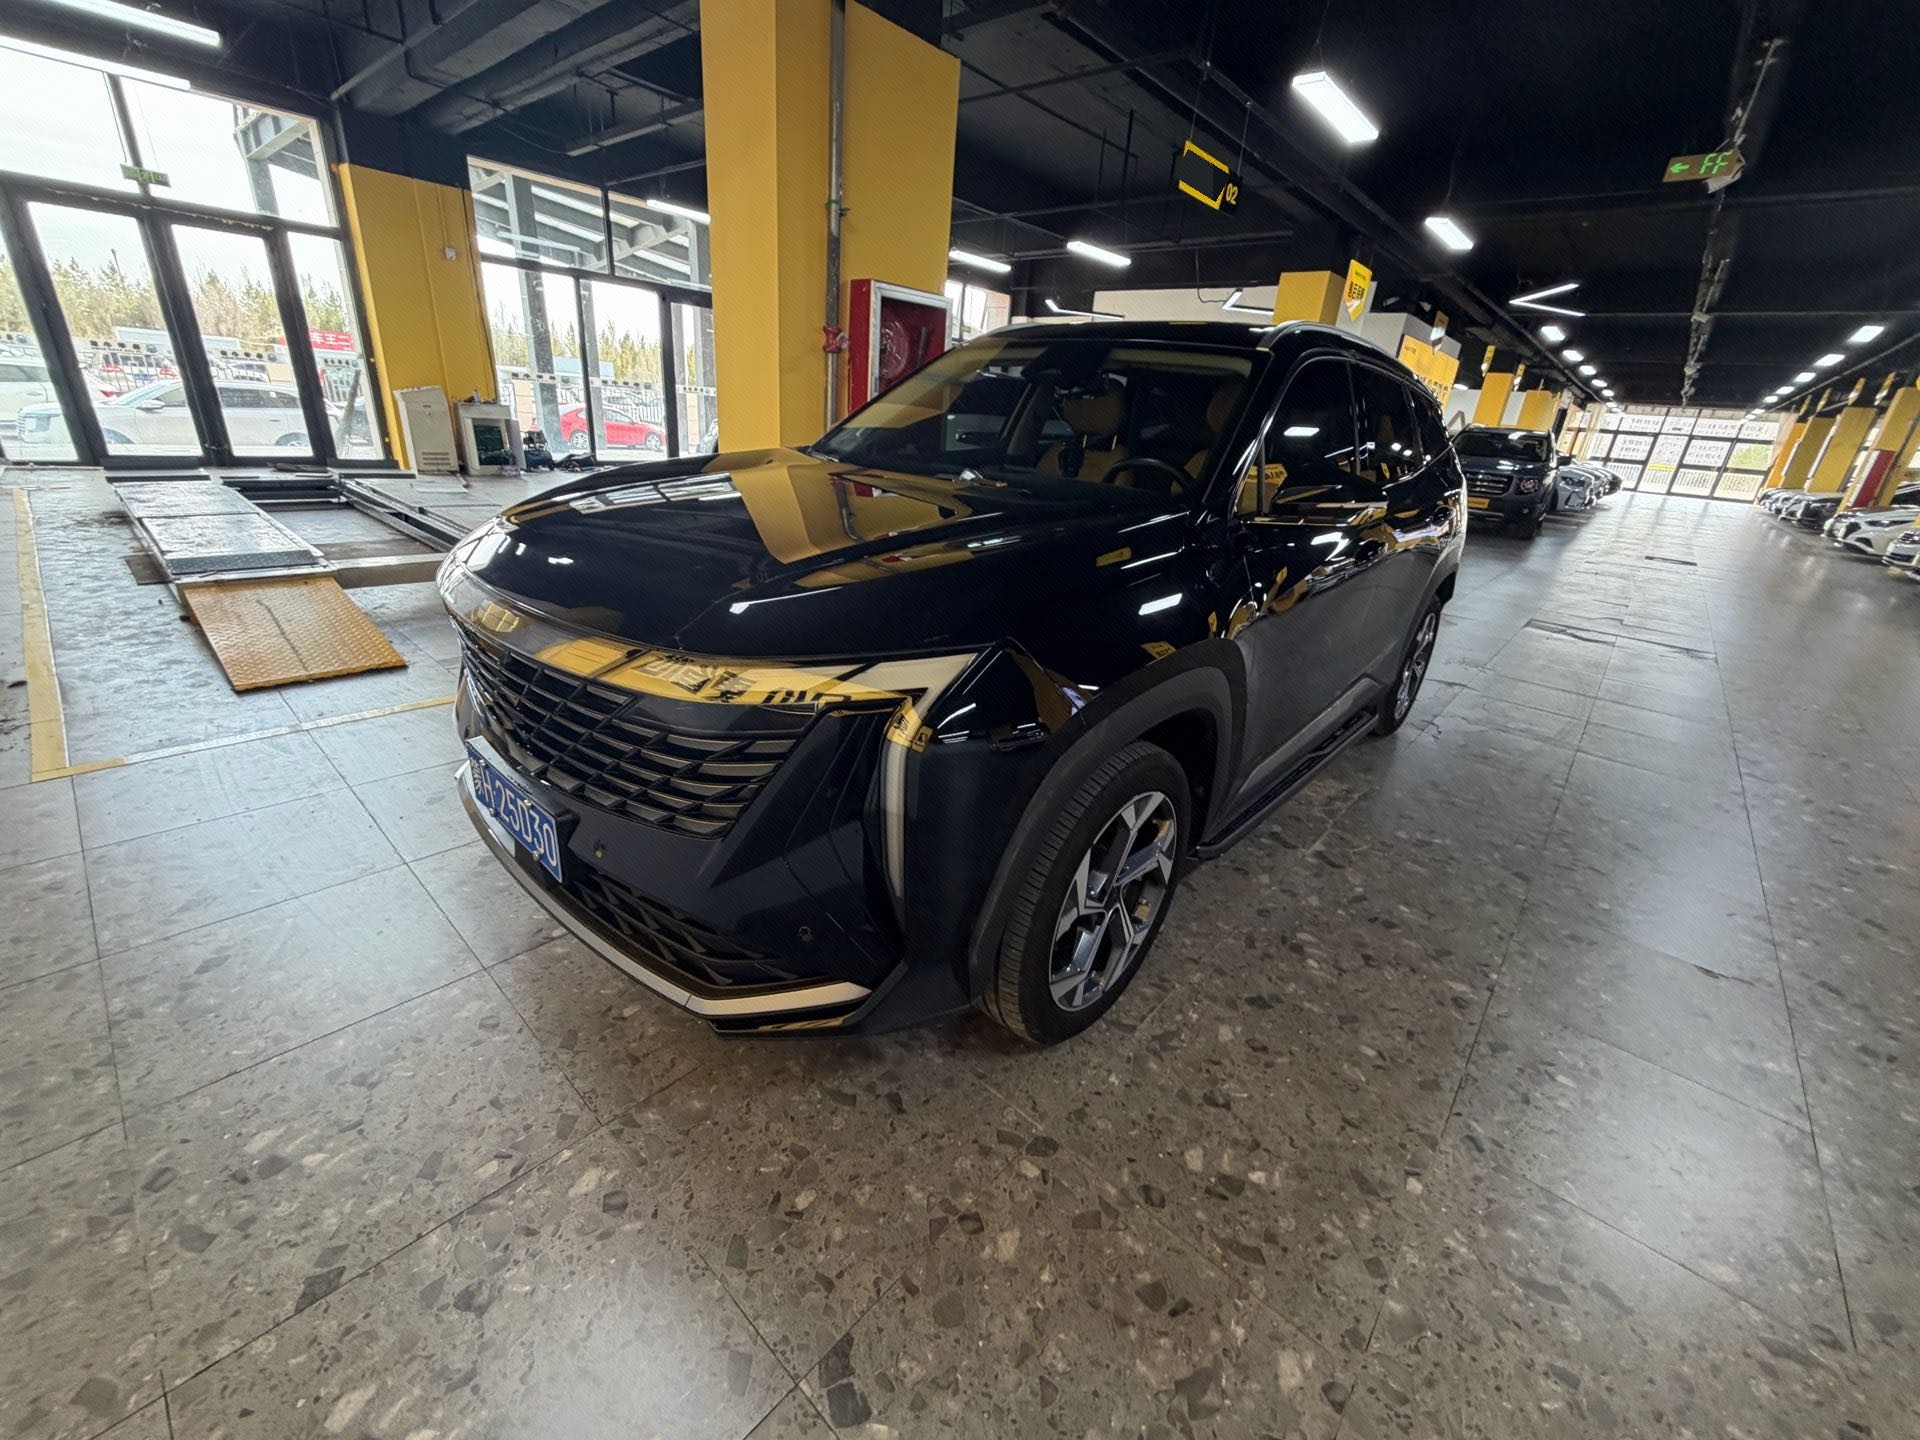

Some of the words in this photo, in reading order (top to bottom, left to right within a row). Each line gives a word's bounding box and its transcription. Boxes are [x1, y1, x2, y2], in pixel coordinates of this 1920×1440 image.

[1225, 182, 1239, 206] 02
[310, 332, 354, 346] 车王二
